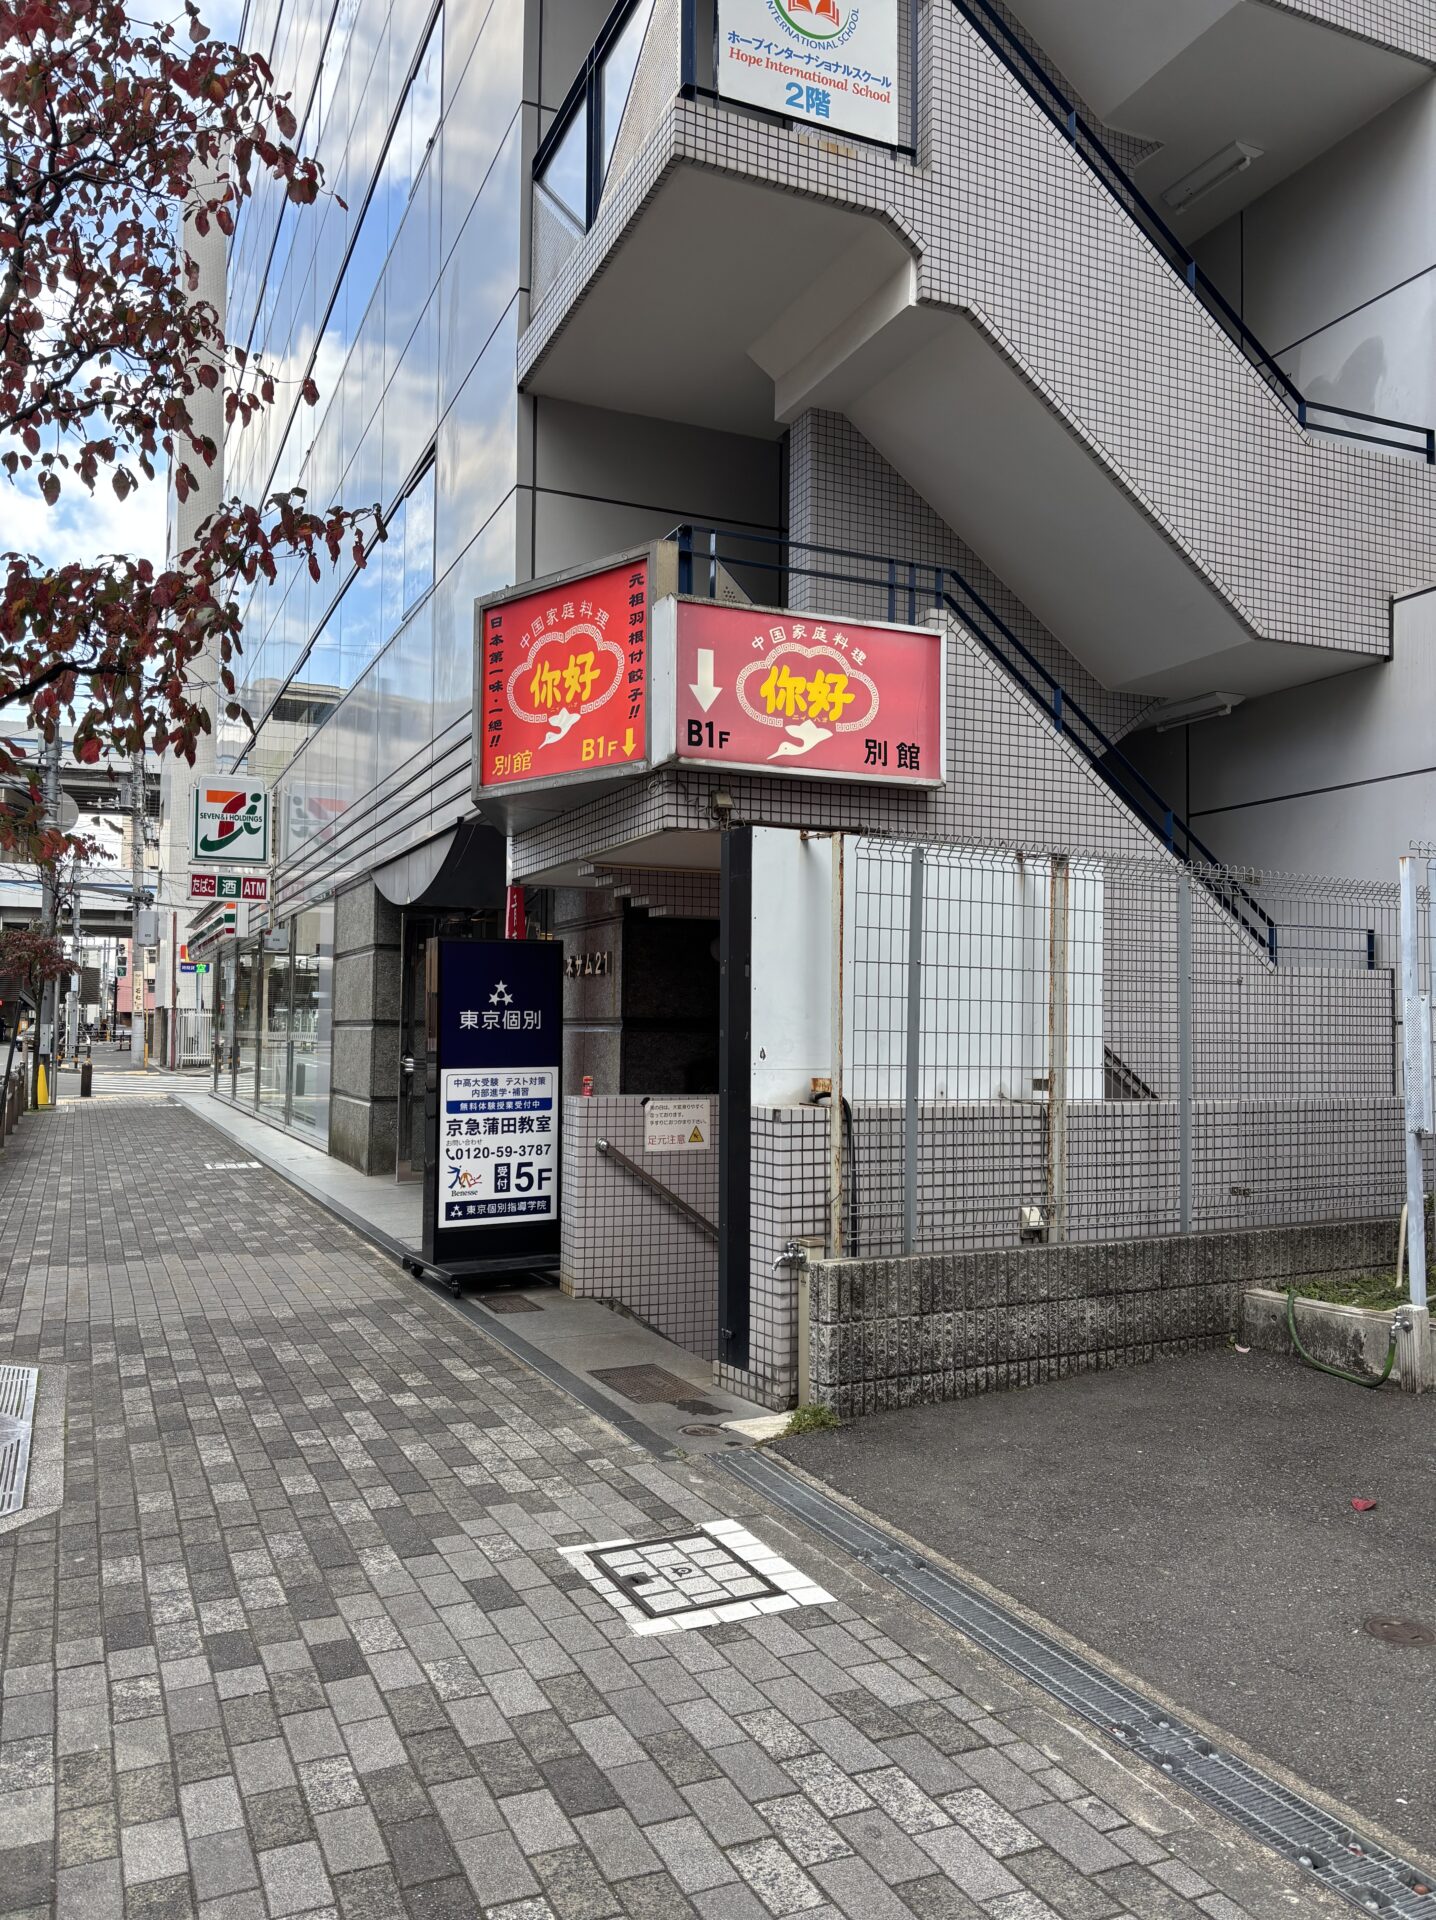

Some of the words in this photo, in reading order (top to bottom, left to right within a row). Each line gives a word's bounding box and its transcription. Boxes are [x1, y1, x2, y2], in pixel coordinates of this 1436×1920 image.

[766, 0, 838, 50] NTERNATIONAL
[838, 8, 859, 46] SCHOOL
[728, 47, 763, 67] Hope
[764, 57, 848, 91] International
[852, 83, 891, 104] School
[785, 82, 831, 119] 2階
[519, 600, 610, 649] 中国家庭料理
[751, 624, 867, 666] 中国家庭料理
[529, 651, 601, 708] 你好
[760, 664, 856, 722] 你好
[687, 718, 731, 749] B1F
[581, 735, 618, 762] B1F
[864, 738, 921, 771] 別館
[492, 750, 533, 776] 別館
[229, 814, 263, 823] HOLDINGS
[192, 878, 215, 893] たばこ
[222, 879, 237, 895] 酒
[244, 881, 265, 896] ATM
[459, 1010, 542, 1030] 東京個別
[453, 1077, 499, 1088] 中高大受験
[505, 1076, 546, 1086] テスト対策
[471, 1087, 530, 1098] 内部進学・補習
[459, 1100, 541, 1111] 無料体験授業受付中
[446, 1115, 552, 1137] 京急蒲田教室
[446, 1138, 482, 1147] お問い合わせ
[455, 1143, 552, 1161] 0120-59-3787
[647, 1134, 686, 1146] 足元注意
[496, 1165, 508, 1190] 受付
[514, 1161, 553, 1193] 5F
[451, 1189, 479, 1197] Benesse
[466, 1200, 547, 1216] 東京個別指導学院
